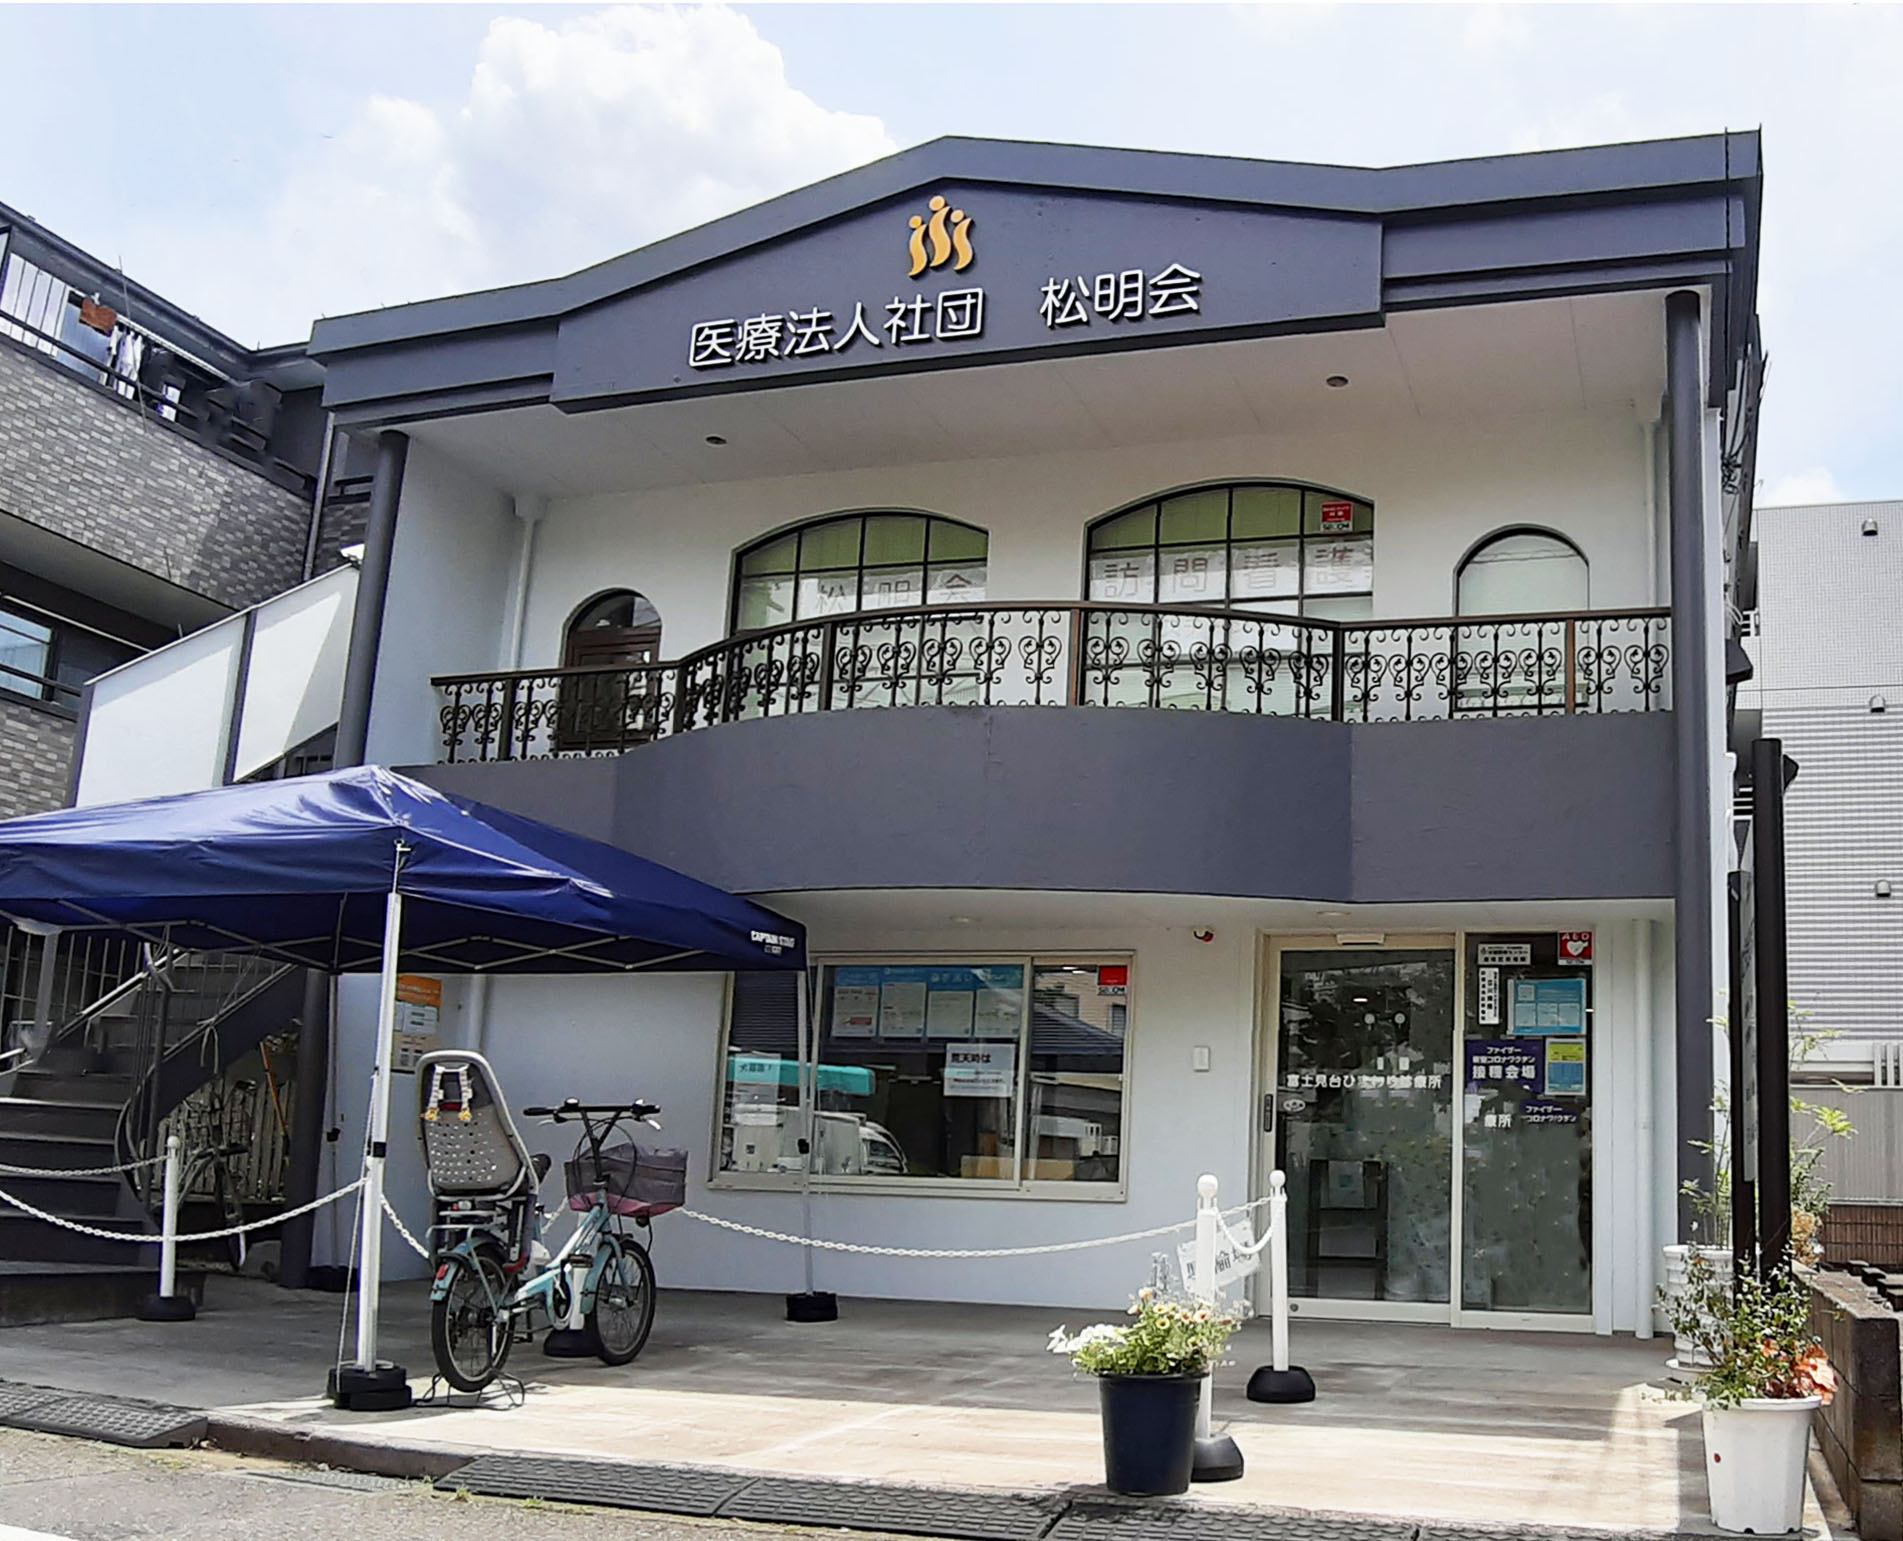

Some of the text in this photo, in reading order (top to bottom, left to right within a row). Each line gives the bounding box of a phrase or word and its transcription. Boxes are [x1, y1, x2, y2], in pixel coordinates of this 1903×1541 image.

[689, 262, 1201, 368] 医療法人社団 松明会
[1103, 546, 1355, 598] 訪問看護
[1561, 933, 1590, 941] AED
[1487, 1046, 1522, 1054] ファイザー
[1472, 1065, 1536, 1079] 接種会場
